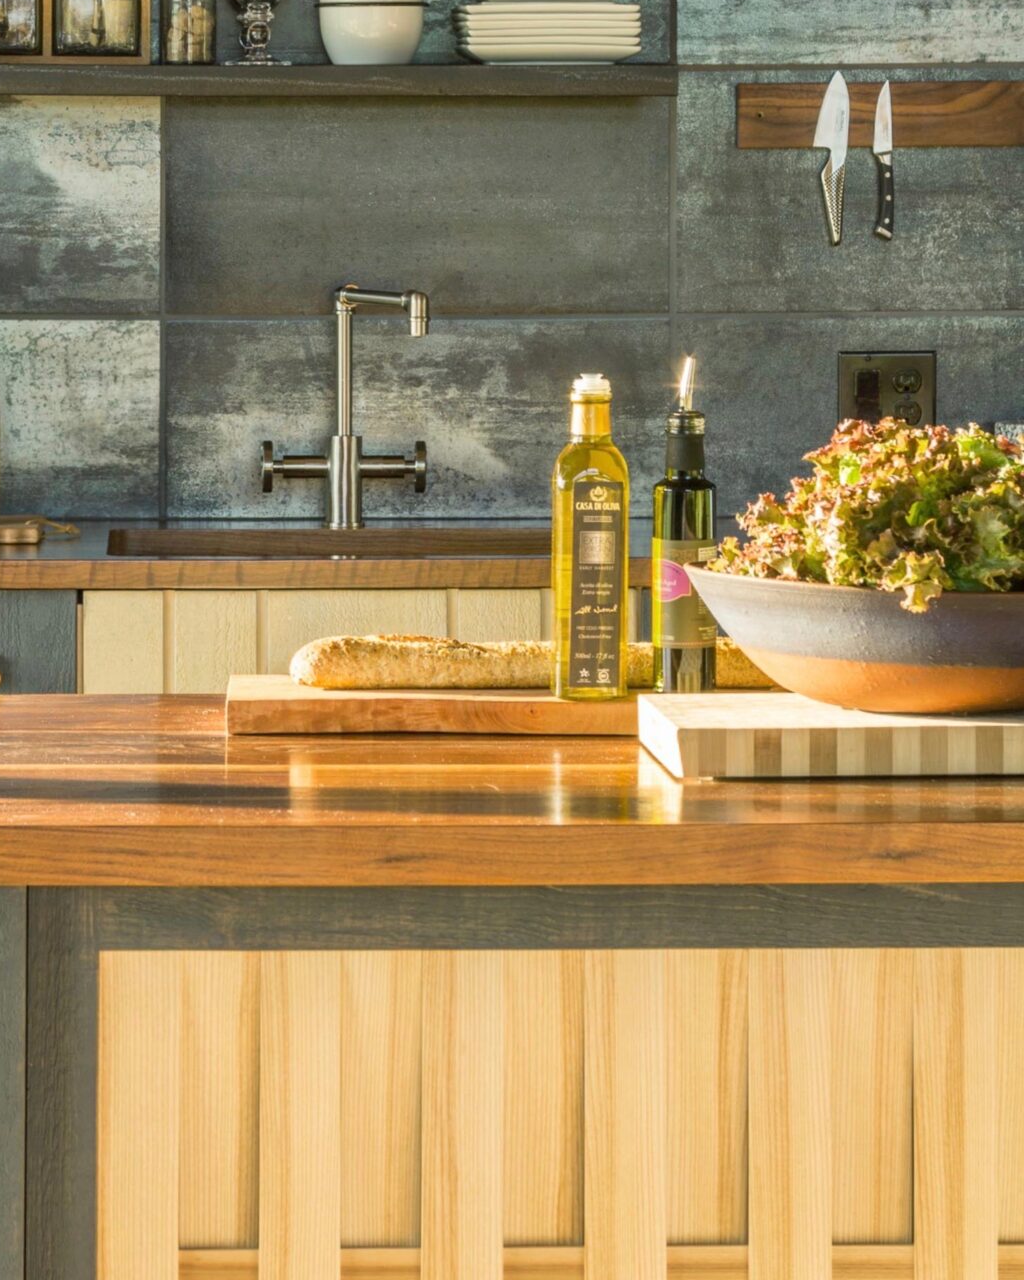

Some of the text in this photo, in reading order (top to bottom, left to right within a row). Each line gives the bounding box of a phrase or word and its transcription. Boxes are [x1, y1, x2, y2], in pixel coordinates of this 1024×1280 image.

[575, 502, 621, 511] CASA DI OLIVA
